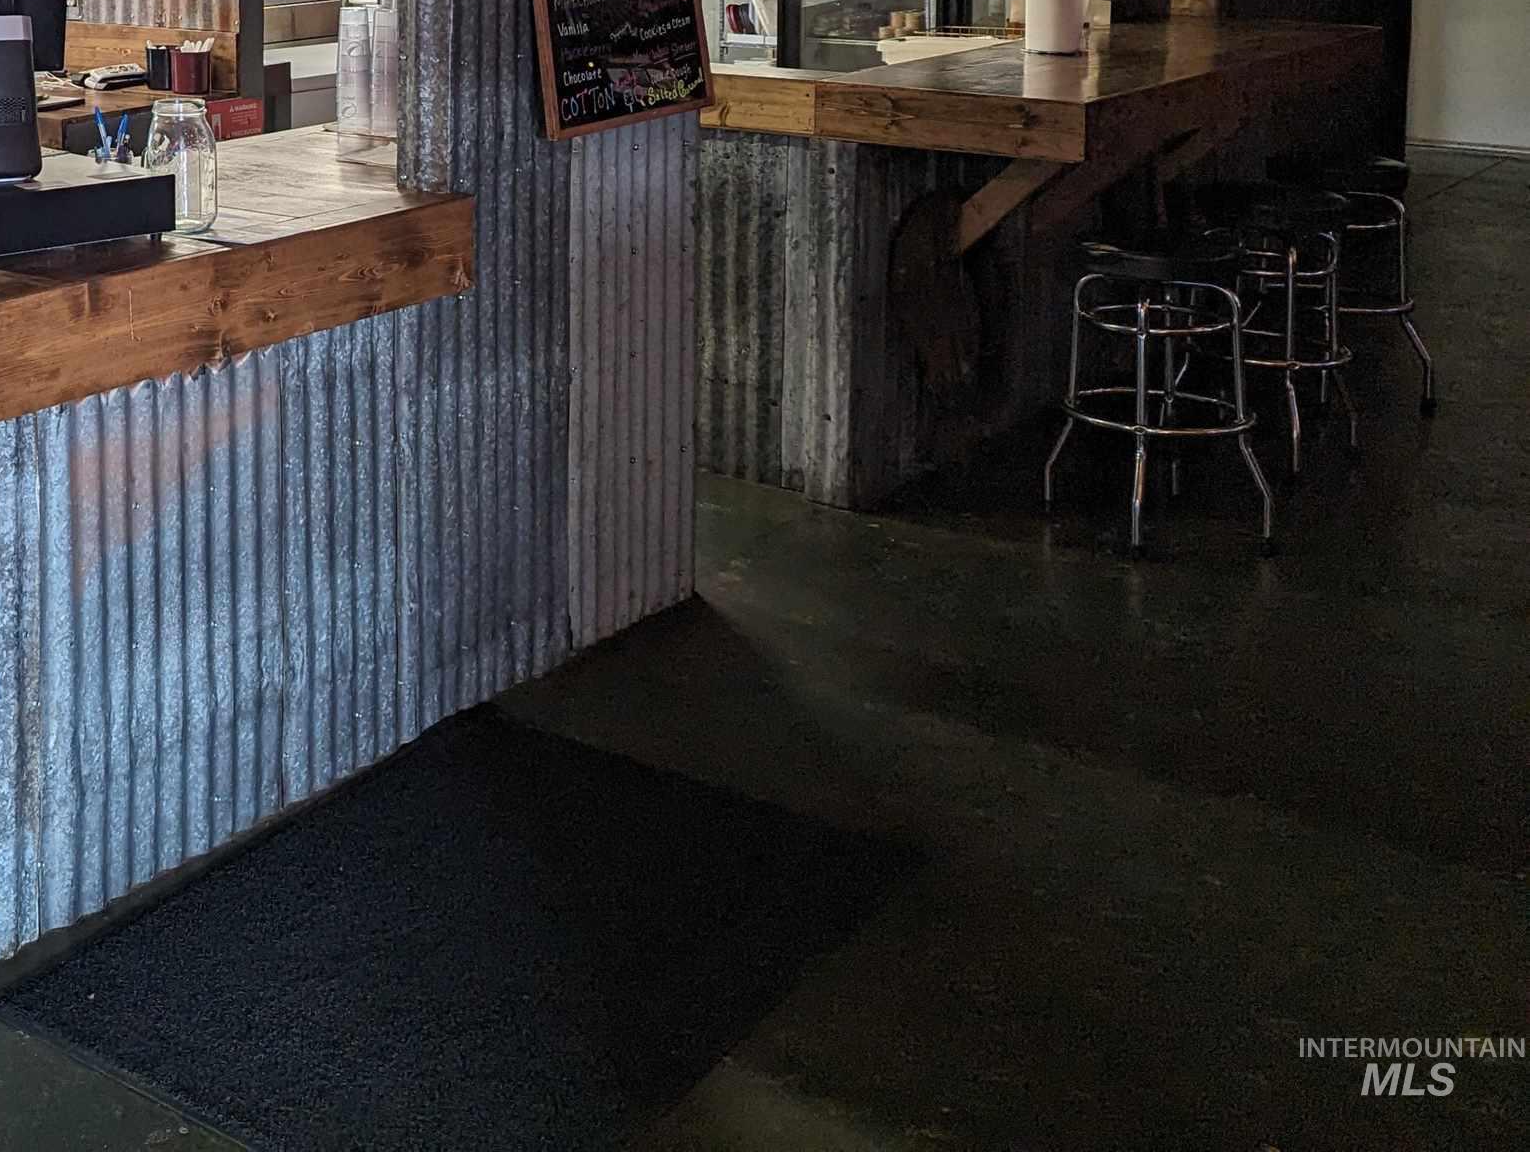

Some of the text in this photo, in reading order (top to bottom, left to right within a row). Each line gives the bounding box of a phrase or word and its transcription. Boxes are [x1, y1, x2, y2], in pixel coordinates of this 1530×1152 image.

[557, 22, 590, 38] Vanilla
[563, 67, 602, 87] Chocolate
[647, 84, 678, 105] Salted
